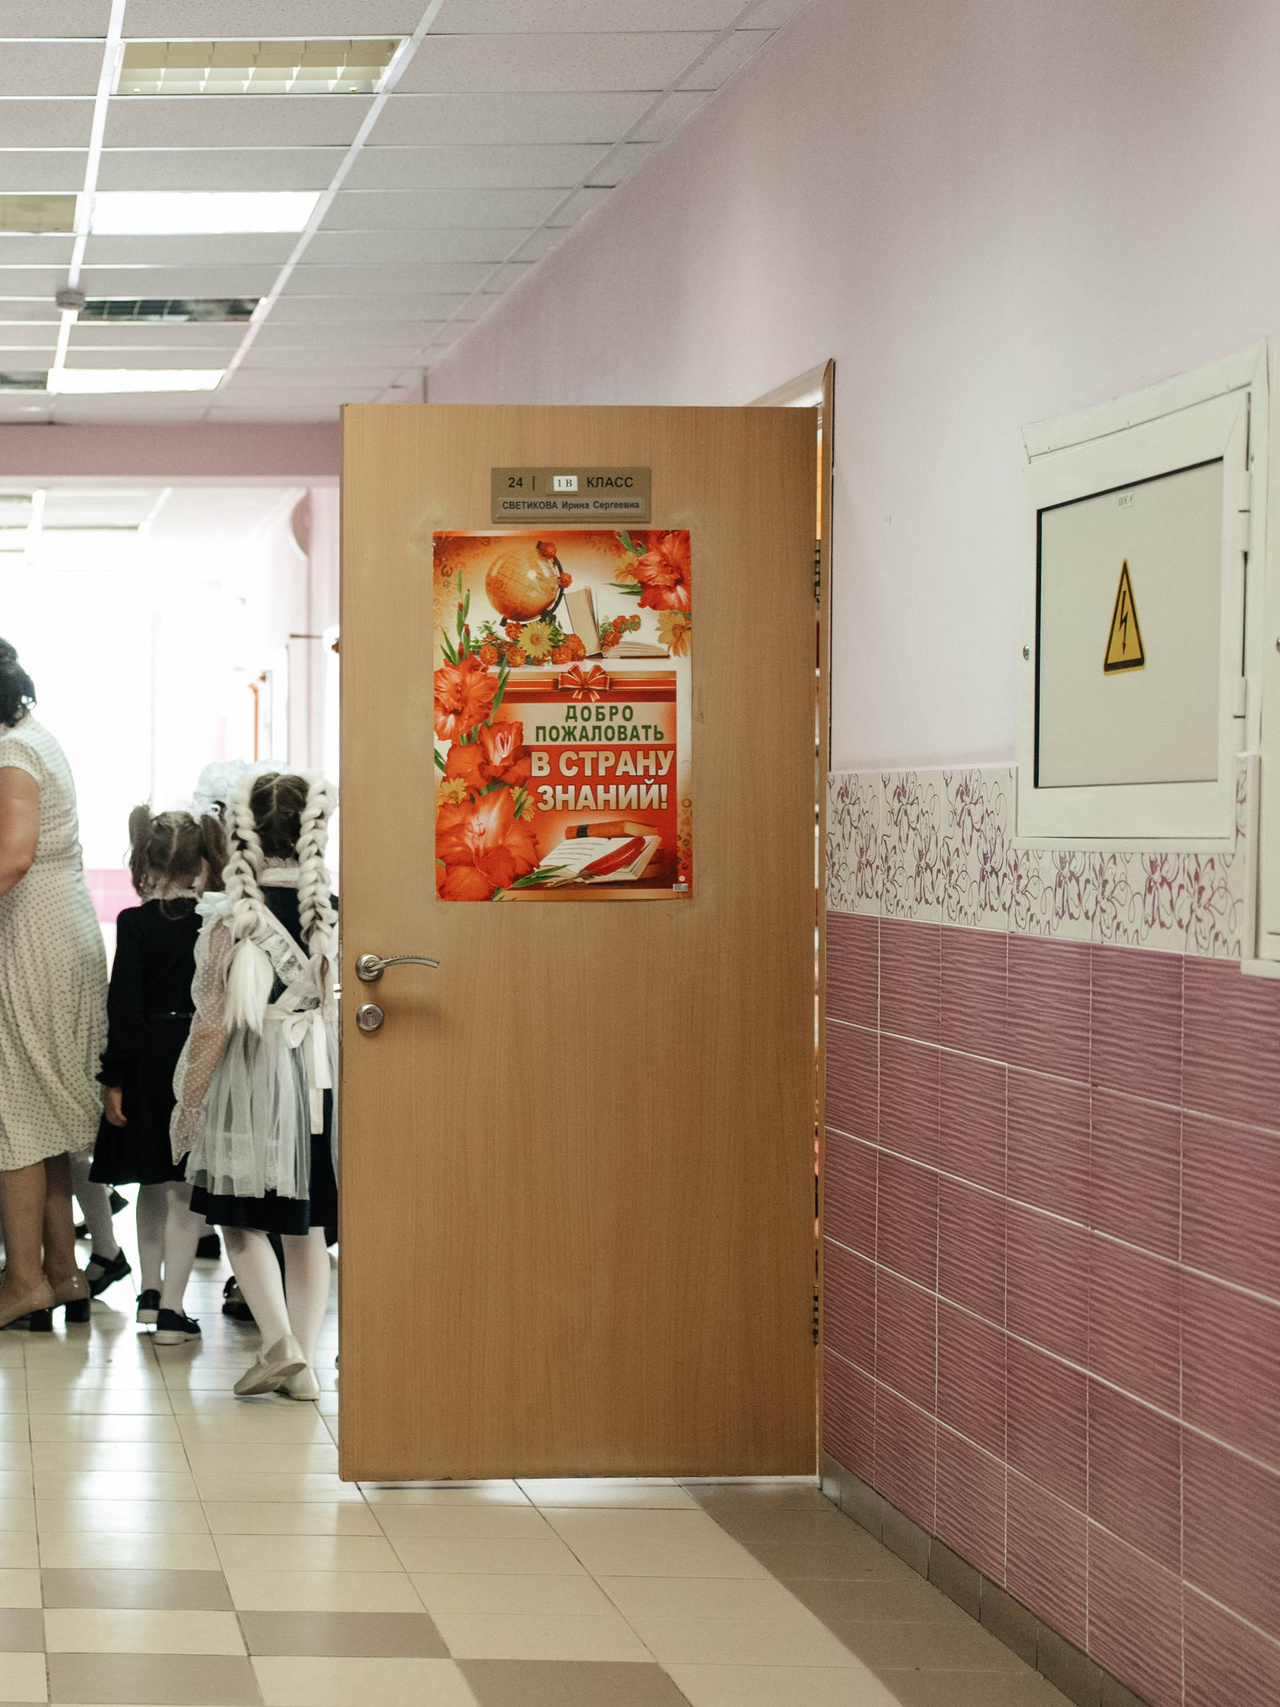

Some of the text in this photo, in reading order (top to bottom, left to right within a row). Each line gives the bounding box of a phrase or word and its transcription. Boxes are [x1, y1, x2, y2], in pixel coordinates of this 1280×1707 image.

[508, 477, 523, 488] 24
[586, 477, 634, 488] КЛАСС
[502, 500, 640, 511] СВЕТИКОВА Ирина Сергеевна
[565, 705, 634, 723] ДОБРО
[535, 725, 665, 742] ПОЖАЛОВАТЬ
[530, 750, 675, 777] В СТРАНУ
[536, 778, 668, 811] ЗНАНИЙ!
